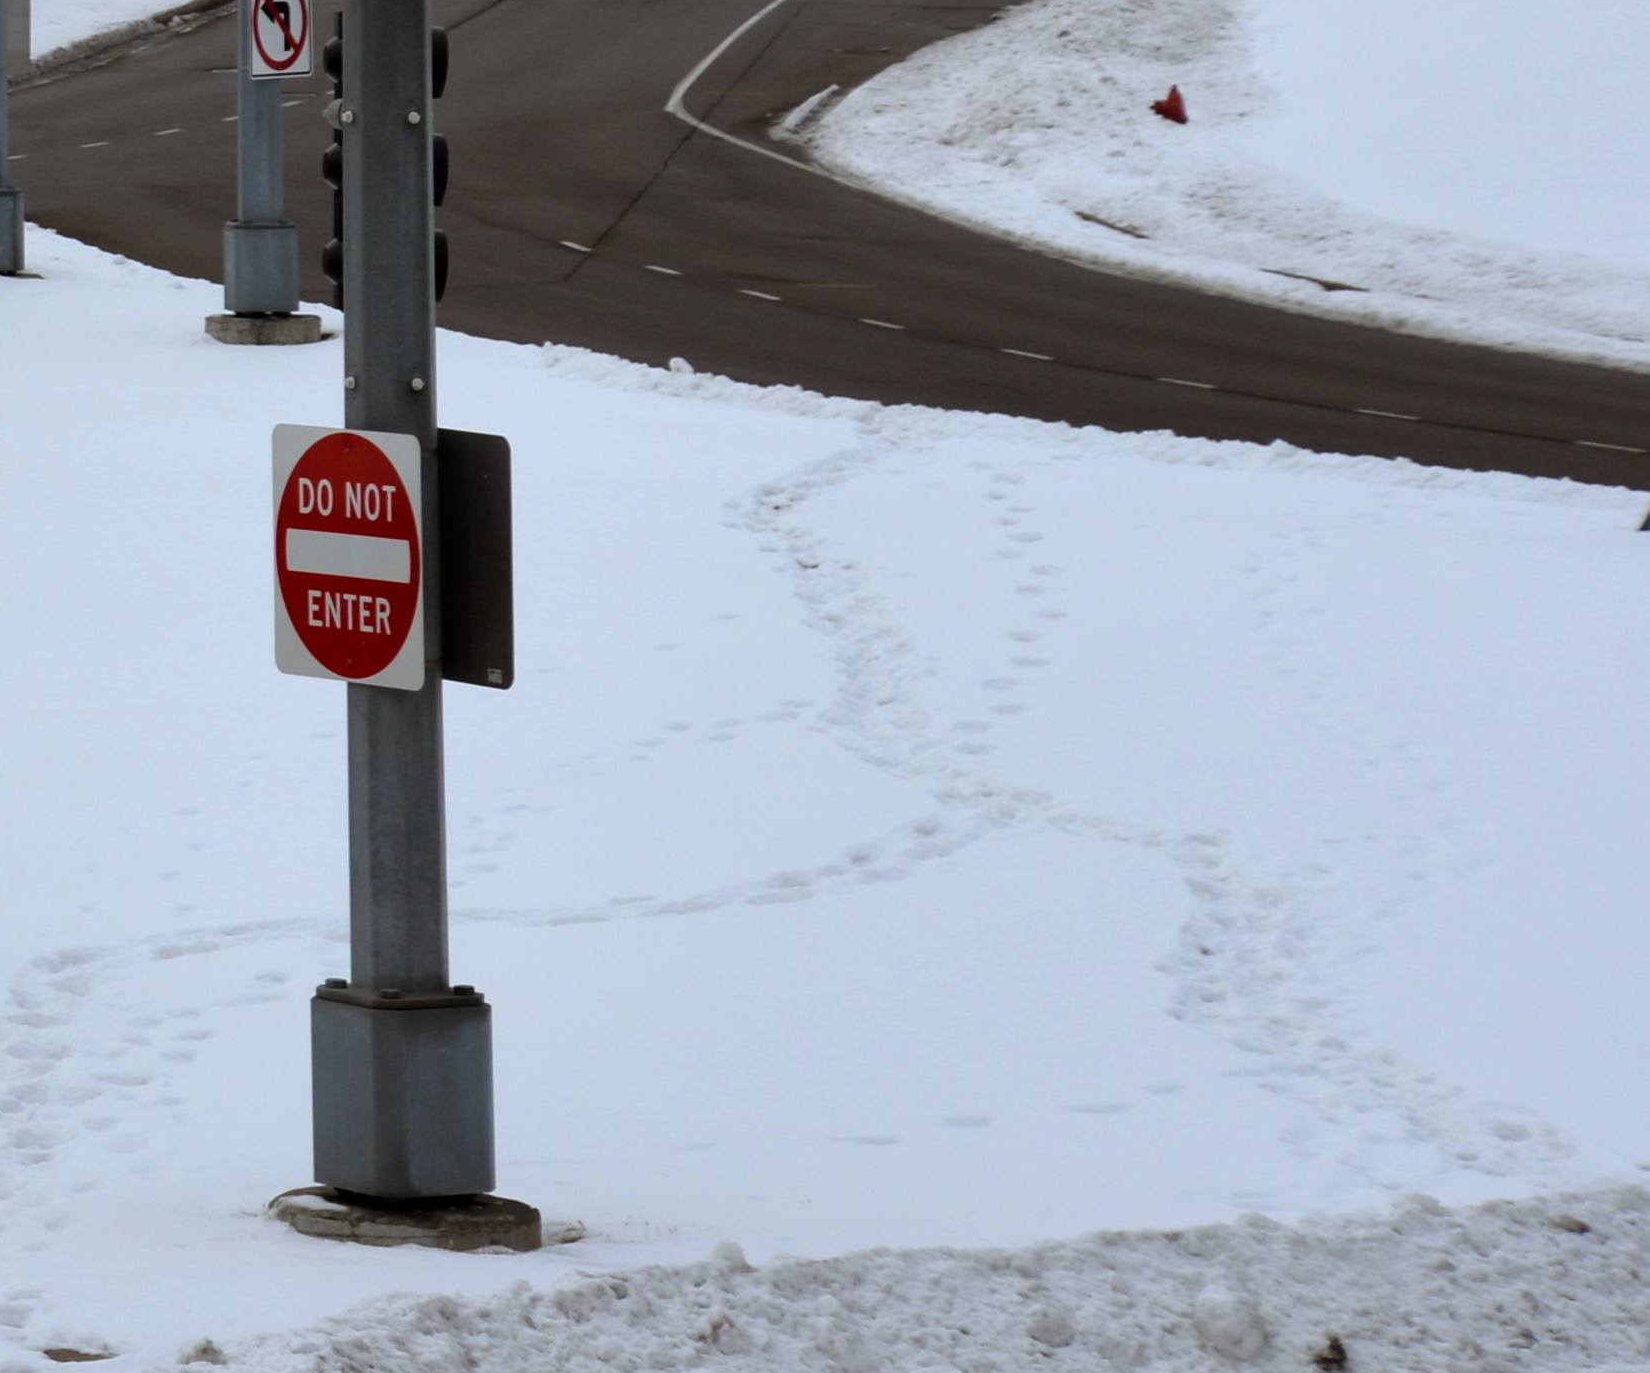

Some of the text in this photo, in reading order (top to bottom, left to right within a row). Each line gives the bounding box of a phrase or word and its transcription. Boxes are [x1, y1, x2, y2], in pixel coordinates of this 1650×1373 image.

[298, 477, 397, 523] DO NOT
[307, 589, 392, 636] ENTER
